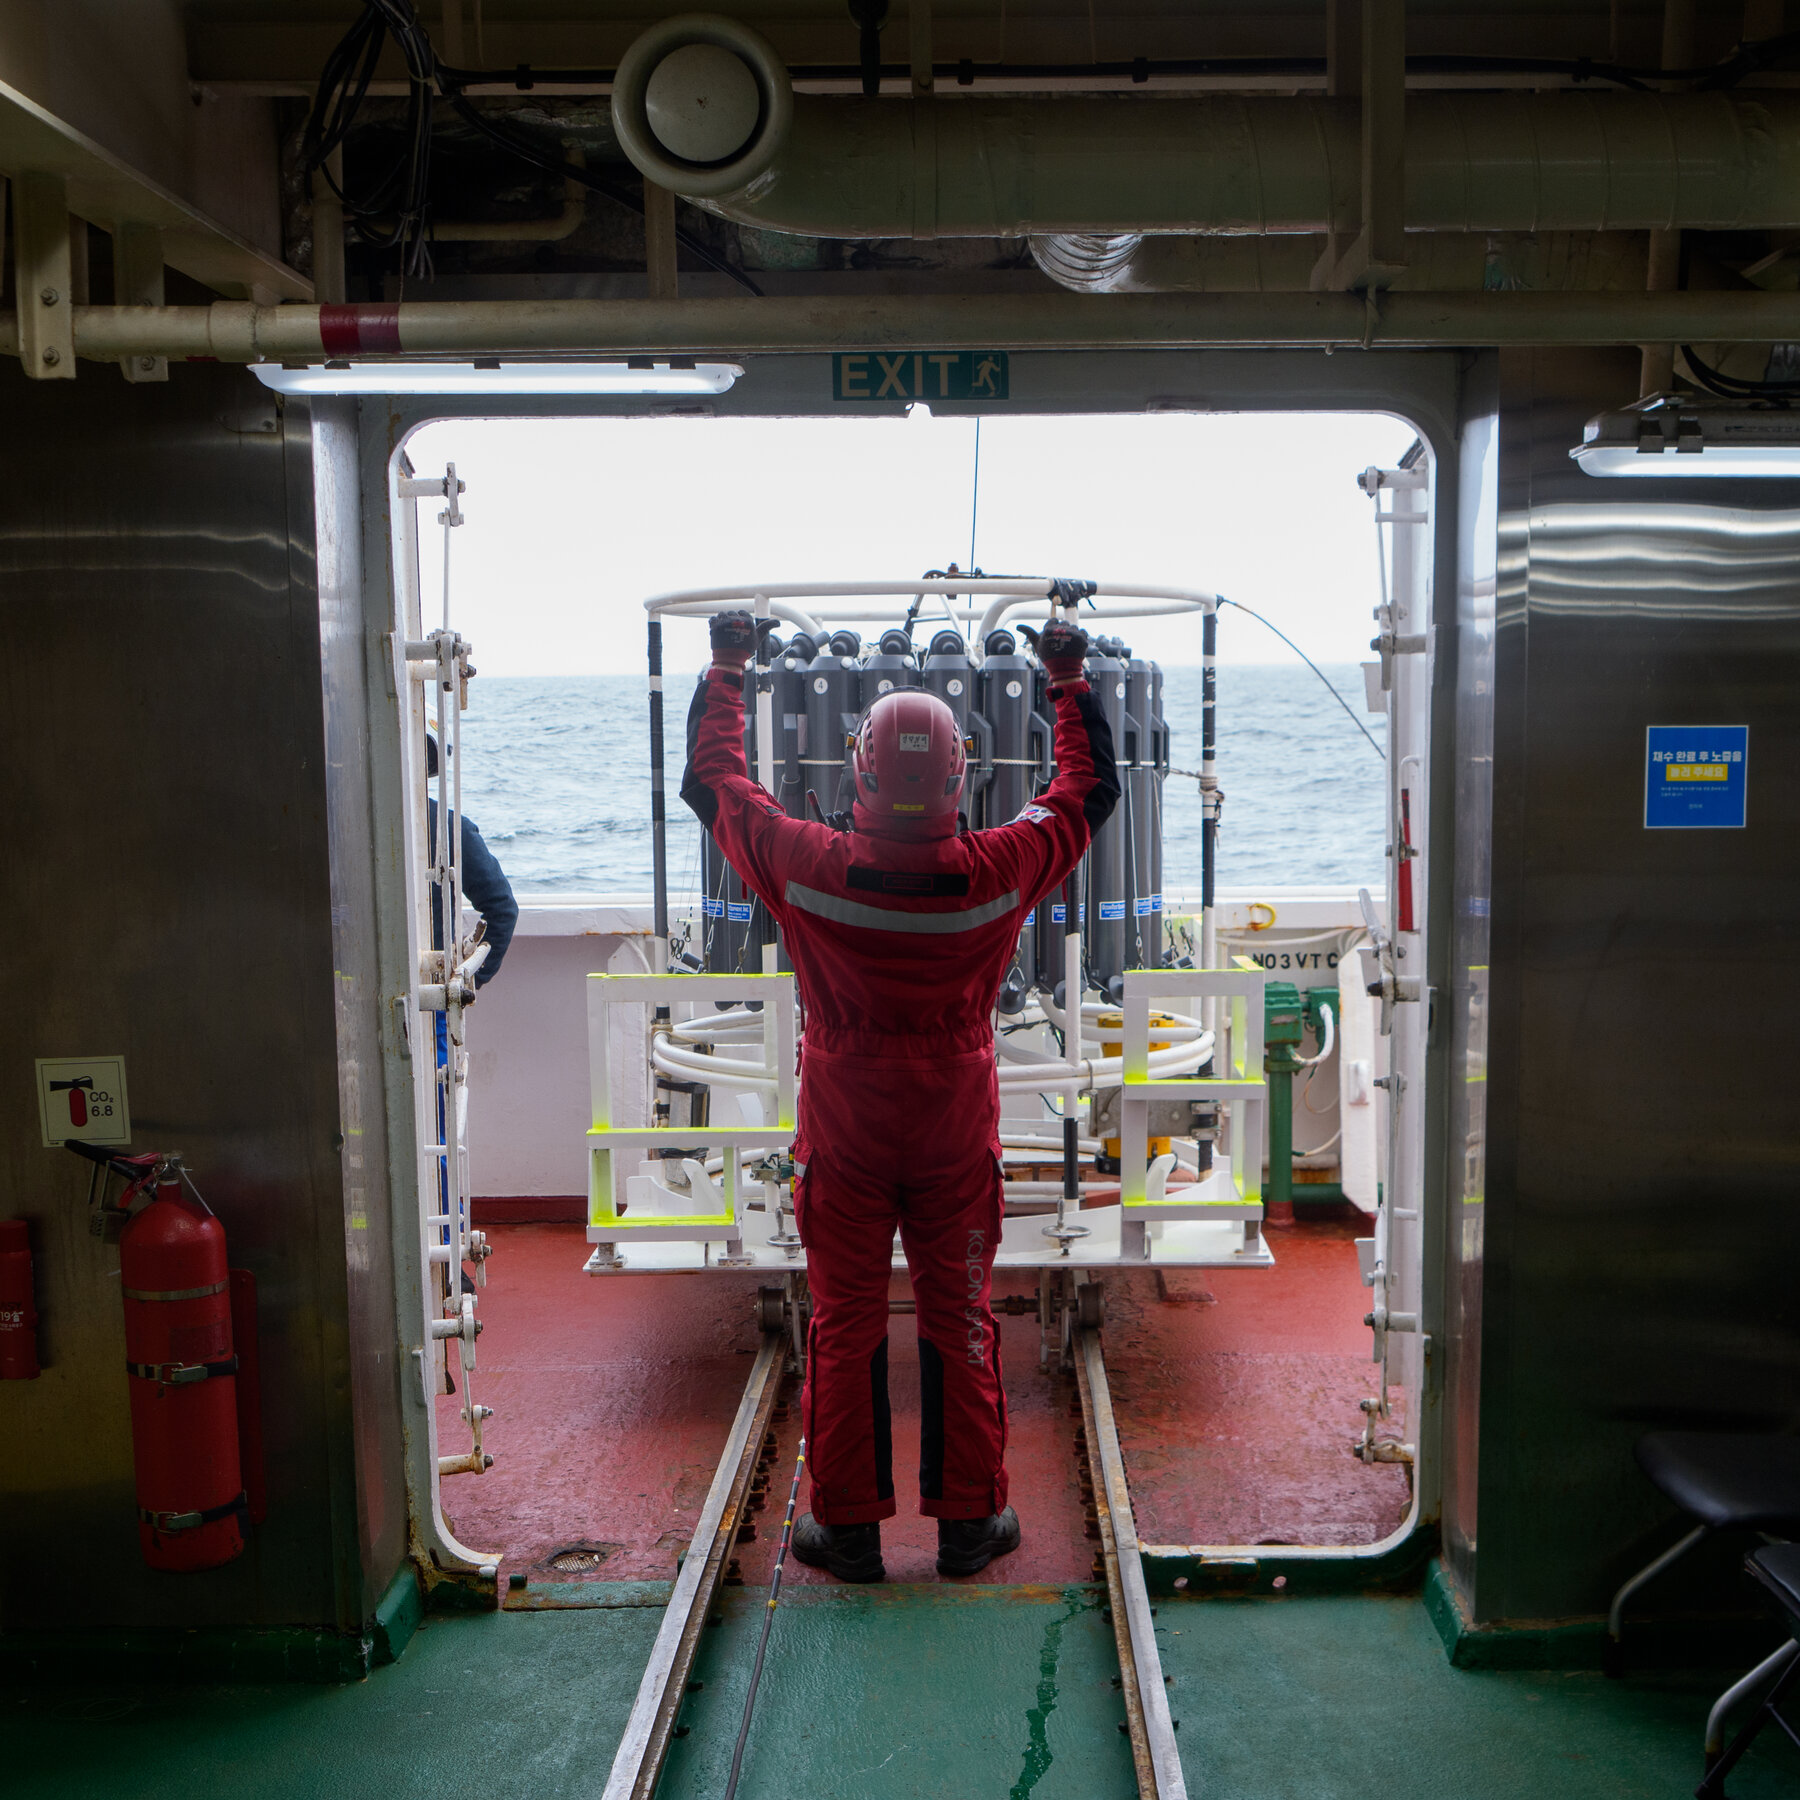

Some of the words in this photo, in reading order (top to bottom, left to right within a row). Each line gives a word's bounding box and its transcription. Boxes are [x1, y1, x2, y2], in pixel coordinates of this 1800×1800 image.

[841, 354, 959, 397] EXIT
[91, 1105, 113, 1116] 6.8
[965, 1229, 985, 1300] KOLON
[964, 1307, 985, 1367] SPORT
